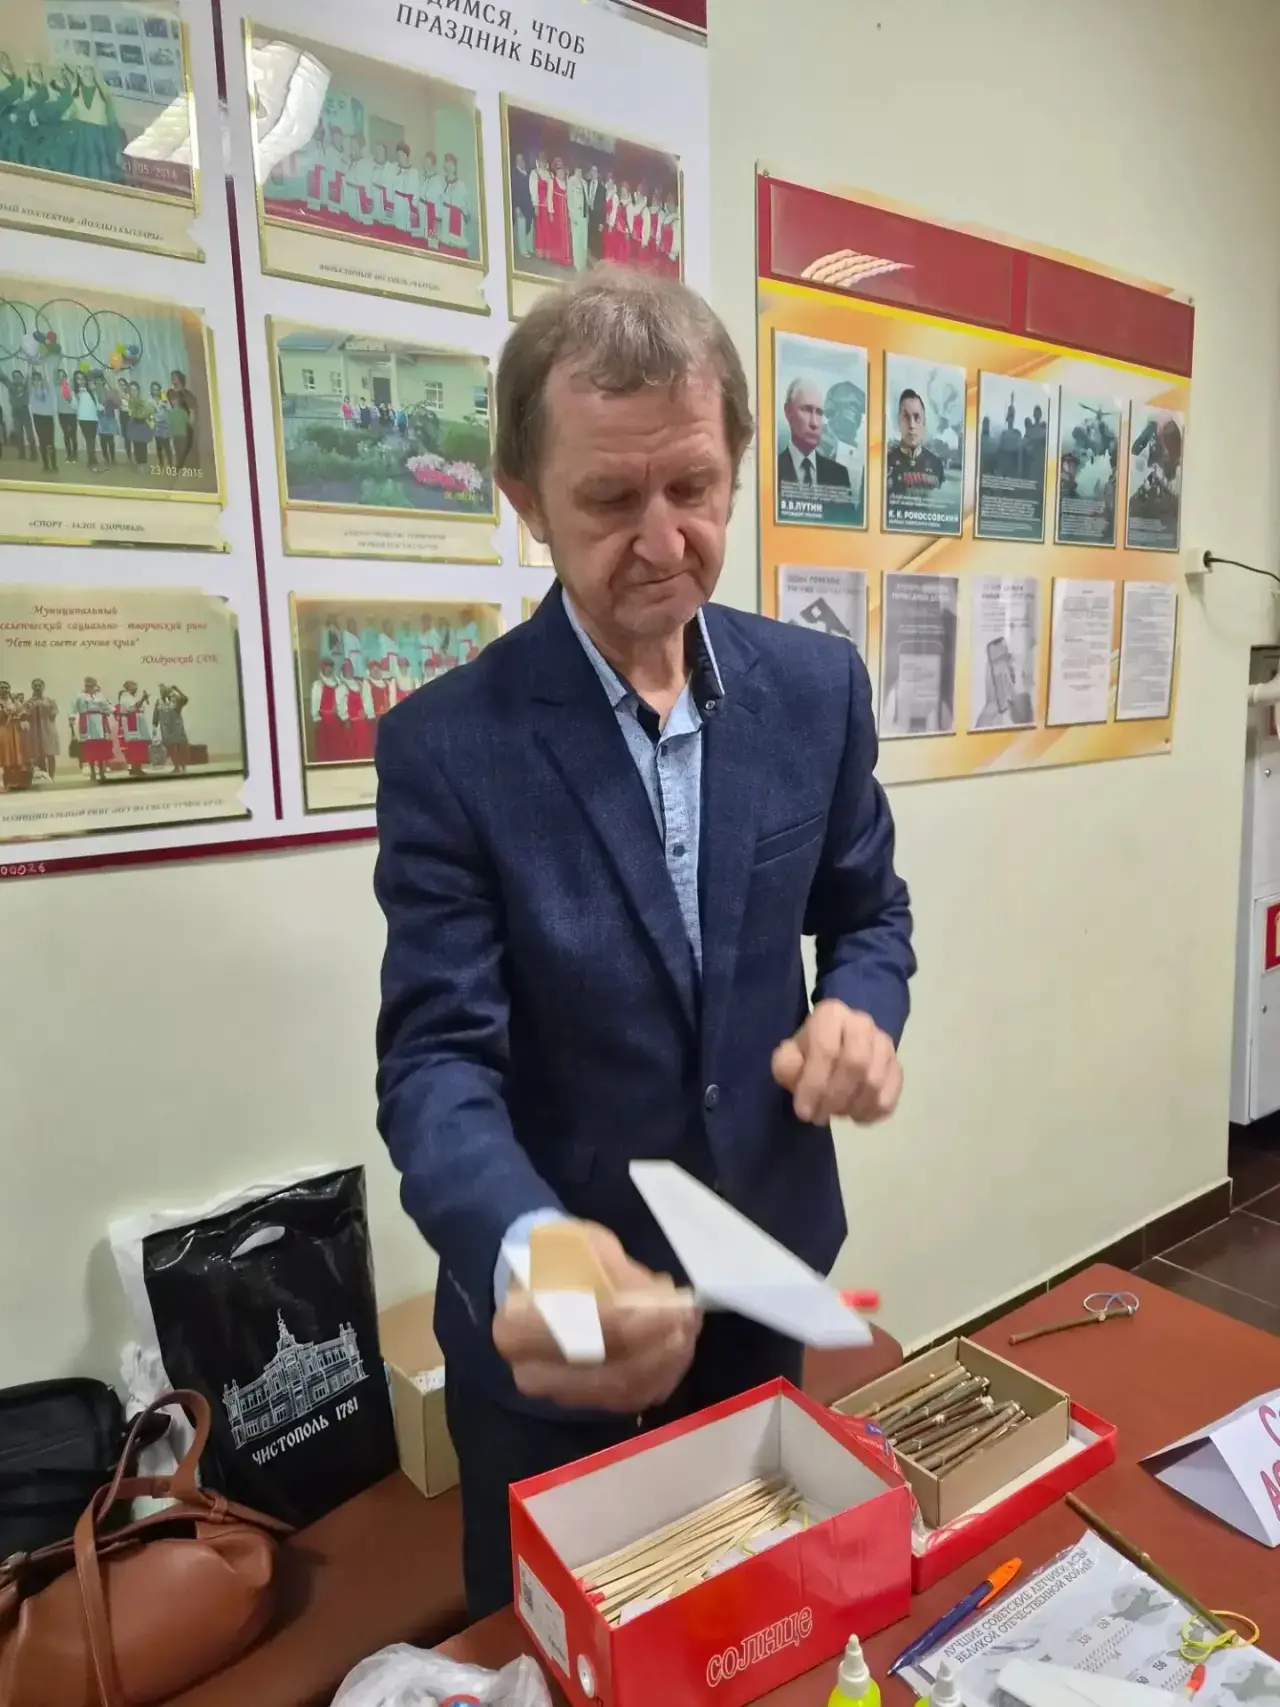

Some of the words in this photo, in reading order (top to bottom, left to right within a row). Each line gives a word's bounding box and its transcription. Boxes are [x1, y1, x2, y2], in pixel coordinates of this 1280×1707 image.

[396, 3, 522, 62] ПРАЗДНИК
[530, 48, 577, 80] БЫЛ
[531, 17, 585, 55] ЧТОБ
[21, 206, 76, 225] КОЛЛЕКТИВ
[34, 605, 118, 617] Муниципальный
[252, 1414, 330, 1465] ЧИСТОПОЛЬ
[336, 1396, 359, 1421] 1781
[943, 1628, 985, 1659] ЛУЧШИЕ
[981, 1589, 1033, 1631] СОВЕТСКИЕ
[954, 1629, 1001, 1664] ВЕЛИКОЙ
[998, 1580, 1067, 1635] ОТЕЧЕСТВЕННОЙ
